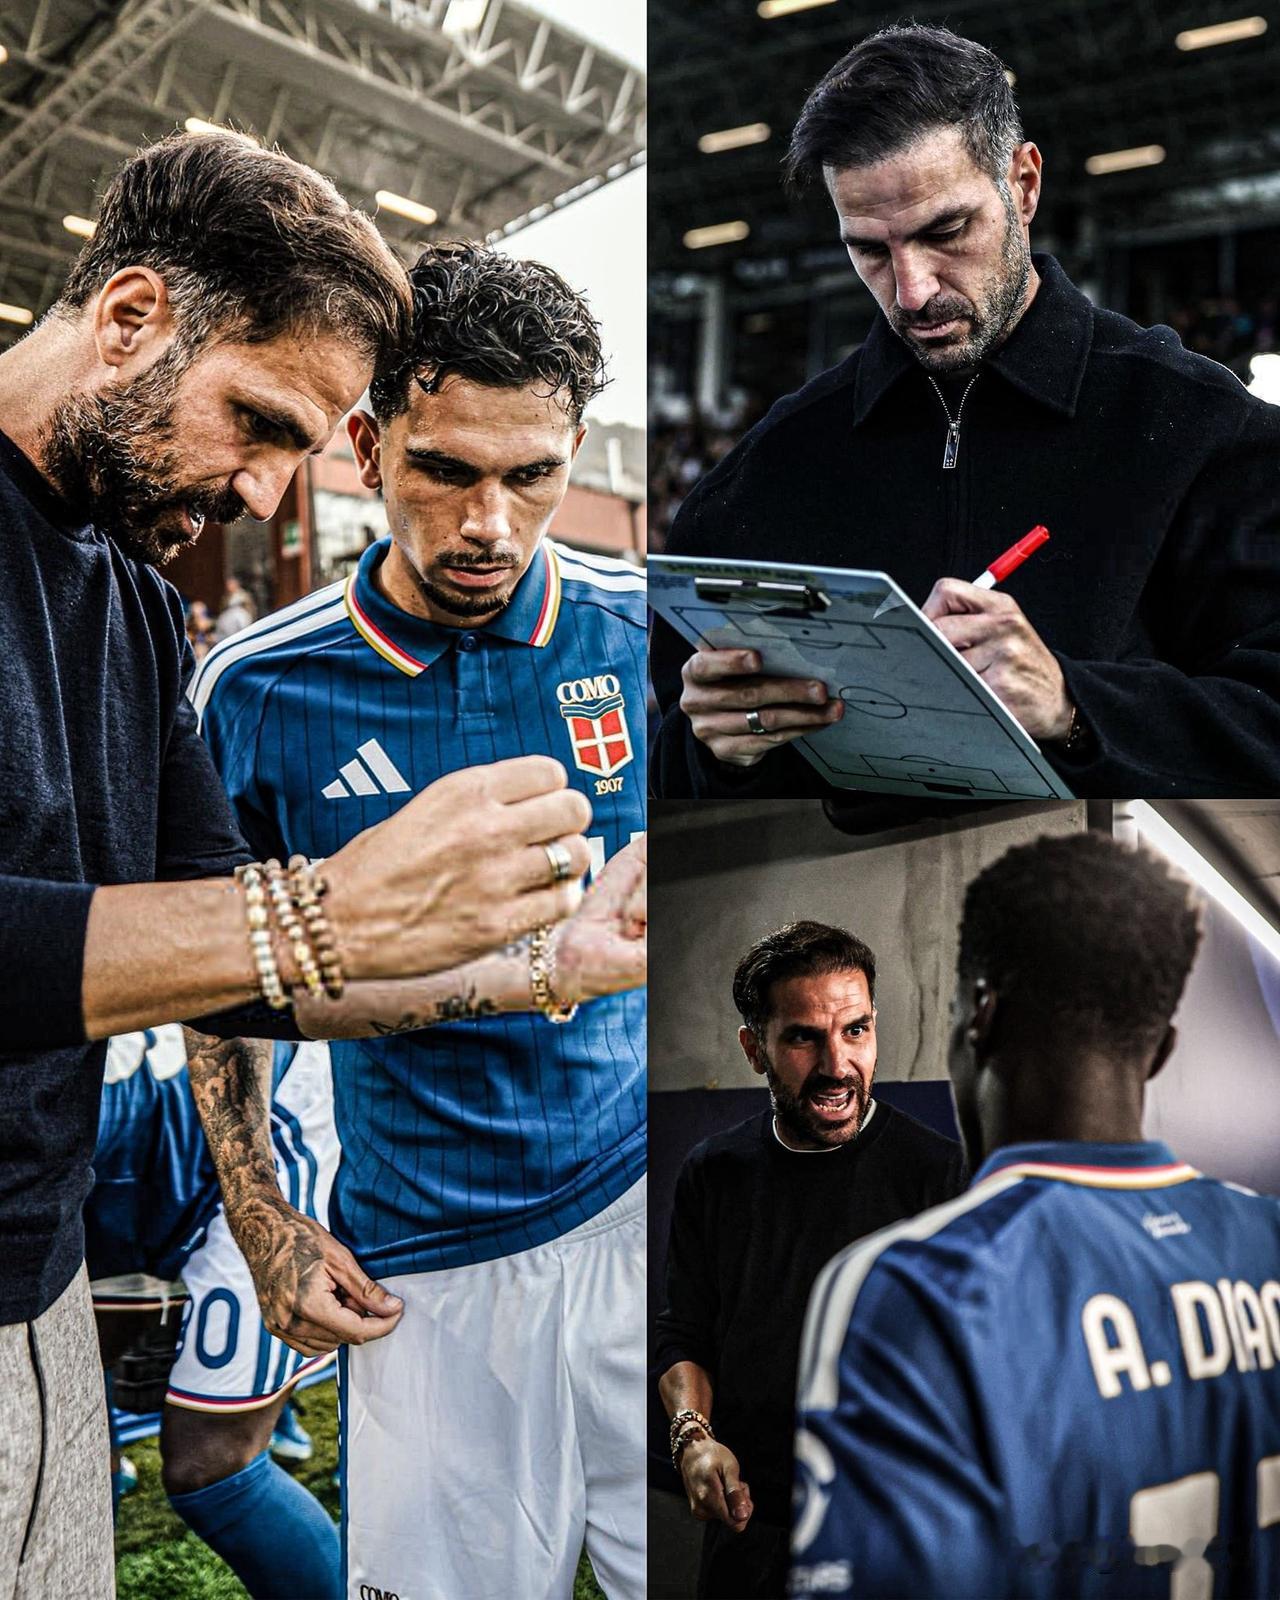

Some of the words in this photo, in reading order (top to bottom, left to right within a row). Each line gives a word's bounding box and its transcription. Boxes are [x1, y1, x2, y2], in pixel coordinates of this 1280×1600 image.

[556, 674, 621, 704] COMO
[594, 777, 624, 796] 1907
[176, 1287, 240, 1370] 0
[1081, 1293, 1172, 1399] A.
